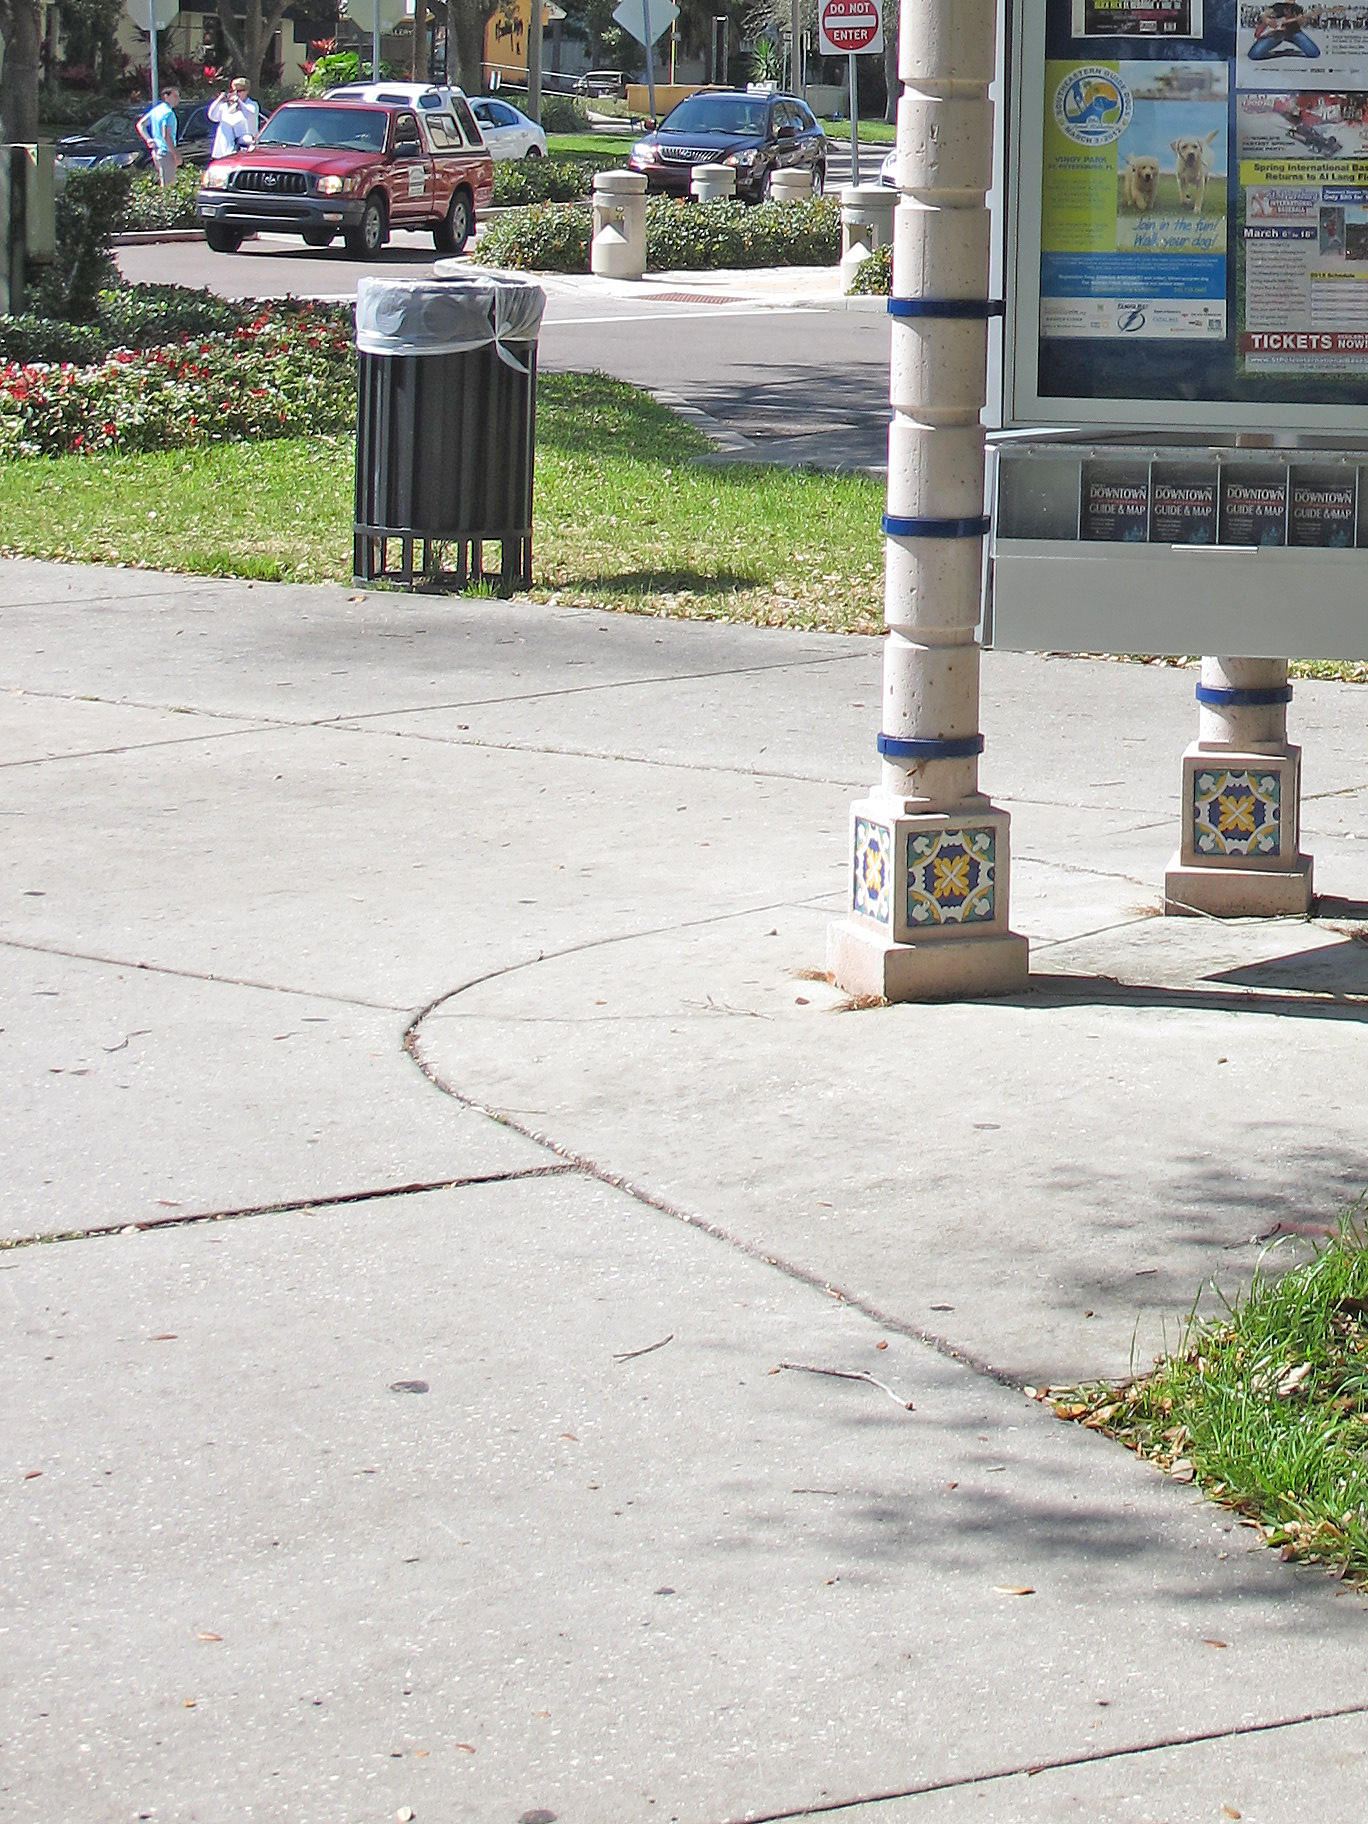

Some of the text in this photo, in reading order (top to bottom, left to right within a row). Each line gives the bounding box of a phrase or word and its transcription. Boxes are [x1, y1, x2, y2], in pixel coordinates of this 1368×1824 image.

[831, 3, 870, 14] DO NOT
[834, 30, 868, 41] ENTER
[1254, 163, 1285, 173] Spring
[1288, 163, 1349, 172] International
[1265, 173, 1303, 181] Returns
[1306, 173, 1316, 181] to
[1331, 173, 1355, 183] Lang
[1132, 217, 1219, 232] Join in the fun!
[1243, 228, 1279, 238] March
[1163, 237, 1190, 250] your
[1191, 234, 1219, 250] dog!
[1250, 334, 1333, 350] TICKETS
[1337, 339, 1368, 349] NOW!
[1089, 487, 1147, 500] DOWNTOWN
[1155, 487, 1212, 501] DOWNTOWN
[1227, 487, 1285, 500] DOWNTOWN
[1294, 490, 1352, 504] DOWNTOWN
[1089, 503, 1146, 516] GUIDE & MAP
[1154, 505, 1212, 517] GUIDE & MAP
[1226, 504, 1284, 516] GUIDE & MAP
[1294, 508, 1352, 520] GUIDE & MAP
